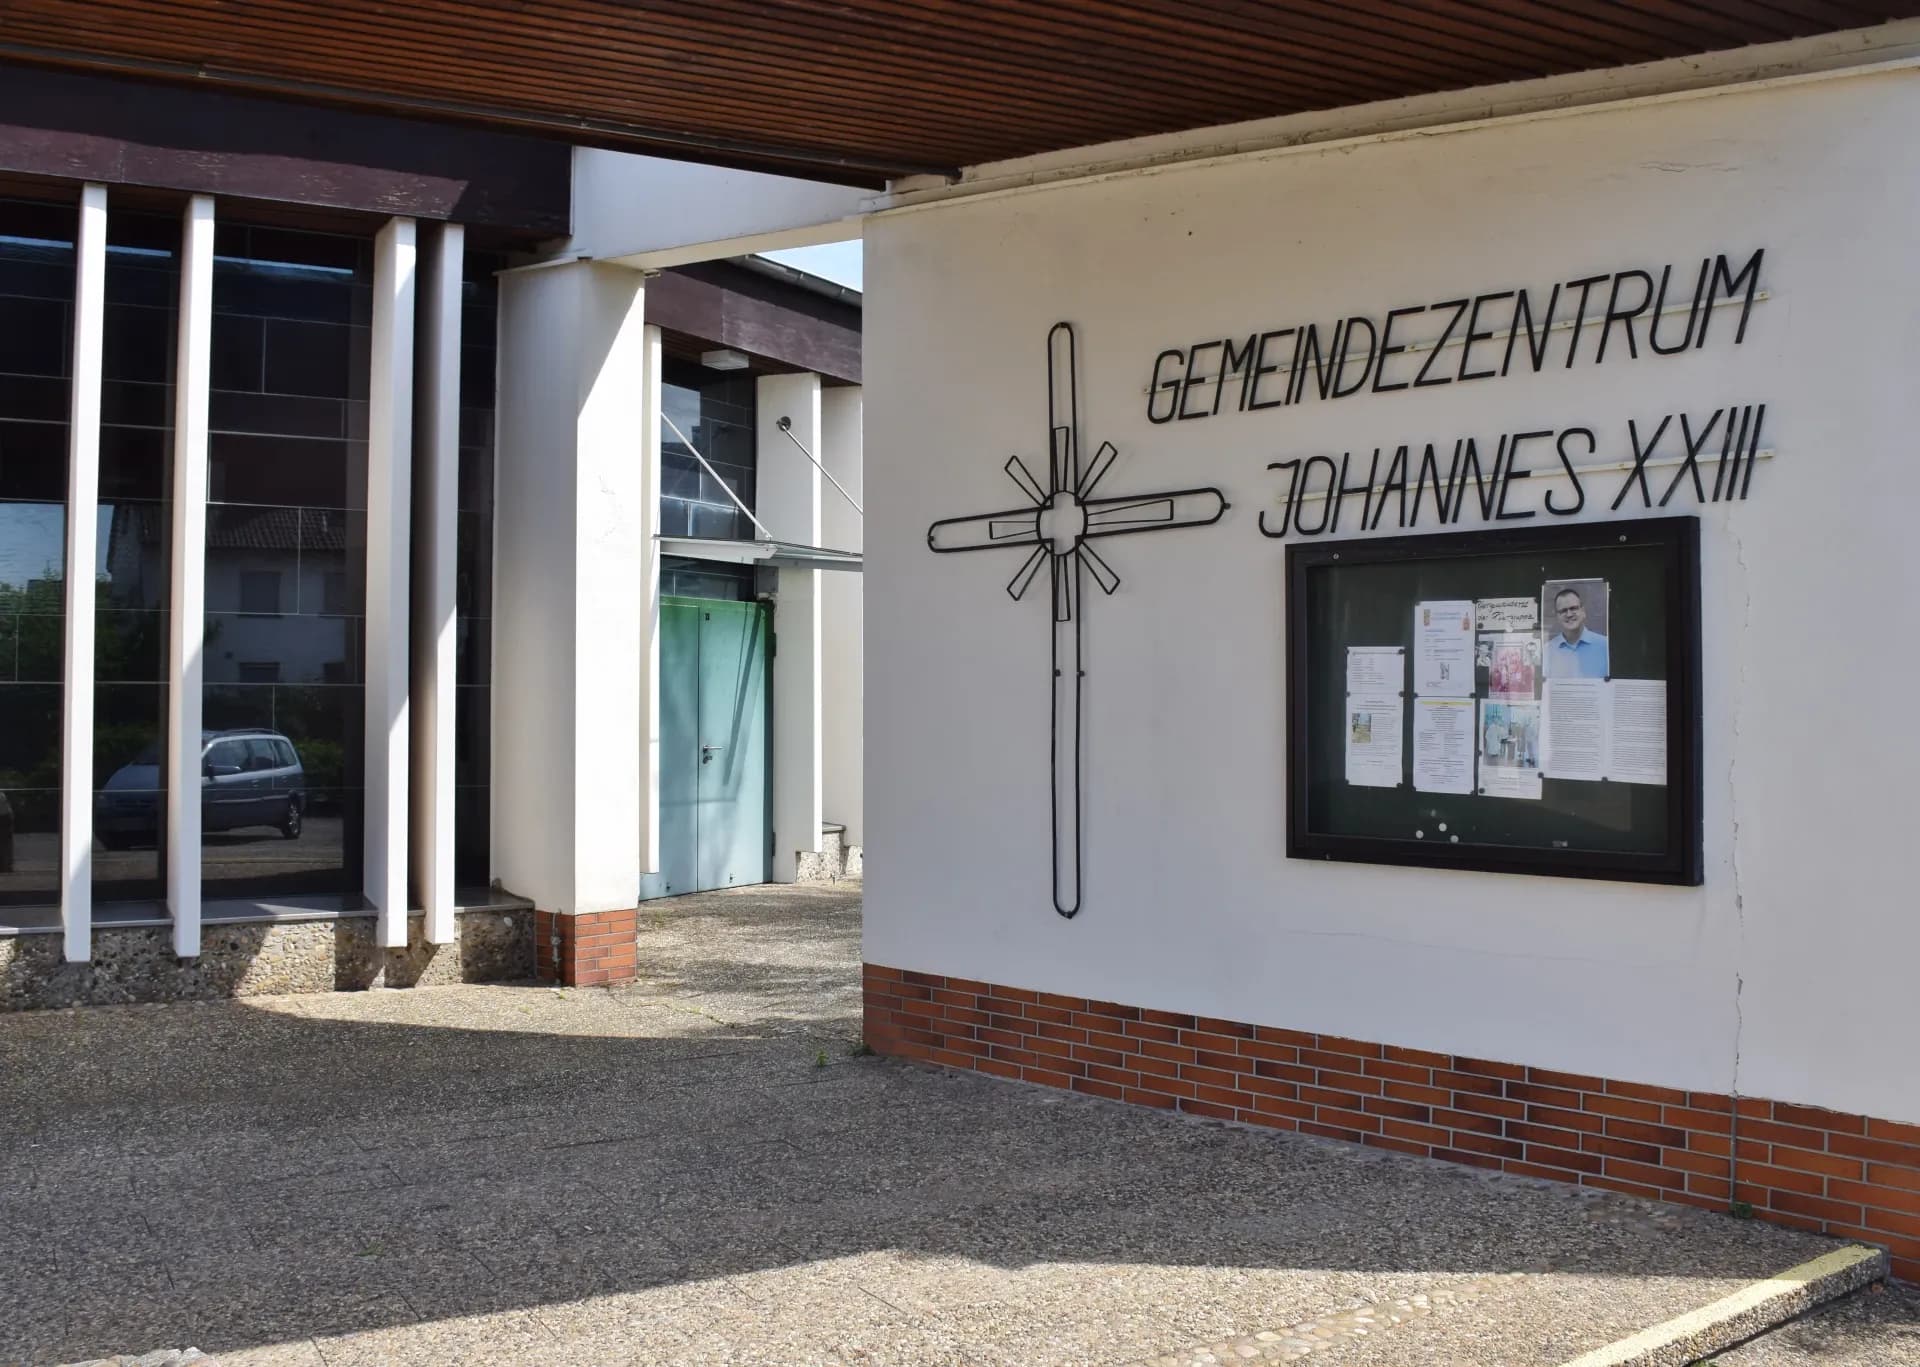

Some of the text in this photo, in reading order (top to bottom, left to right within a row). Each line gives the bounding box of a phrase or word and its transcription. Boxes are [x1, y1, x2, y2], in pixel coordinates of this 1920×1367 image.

[1146, 248, 1765, 424] GEMEINDEZENTRUM
[1258, 403, 1766, 539] JOHANNES XXIII
